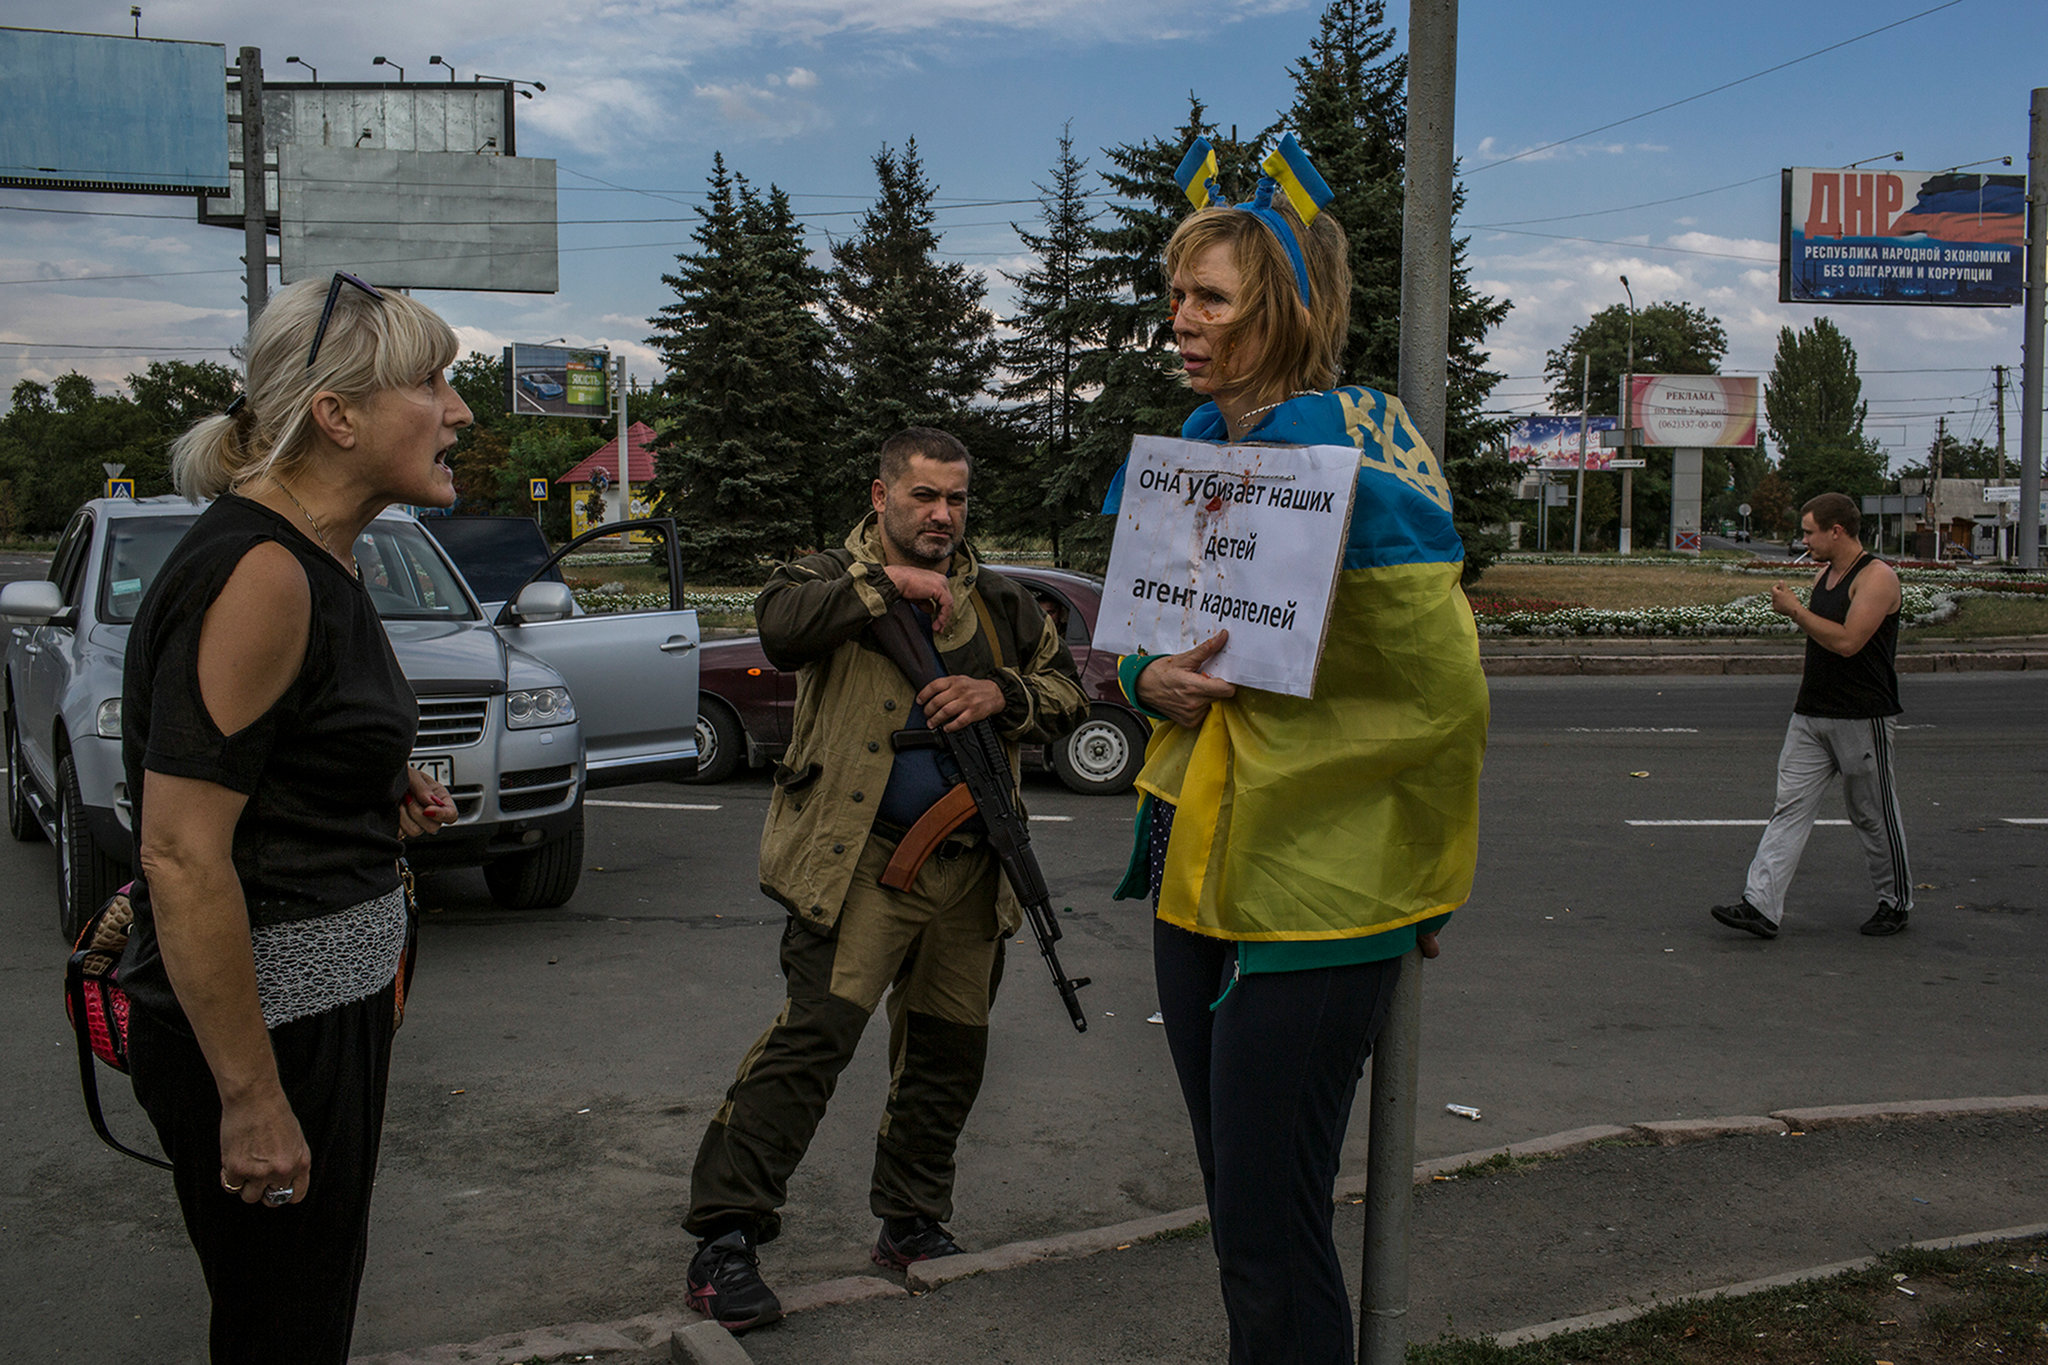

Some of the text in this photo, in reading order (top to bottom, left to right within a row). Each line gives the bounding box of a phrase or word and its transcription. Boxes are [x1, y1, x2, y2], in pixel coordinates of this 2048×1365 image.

[1804, 173, 1904, 240] ДНР
[1805, 246, 2011, 263] РЕСПУБЛИКА НАРОДНОЙ ЭКОНОМИКИ
[1823, 265, 1993, 282] БЕЗ ОЛИГАРХИИ И КОРРУПЦИИ
[1665, 391, 1715, 401] РЕКЛАМА
[1658, 420, 1722, 429] (062)337-00-00
[1187, 473, 1266, 506] убивает
[1268, 485, 1335, 513] наших
[1204, 532, 1258, 561] детей
[1132, 578, 1297, 631] агент карателей
